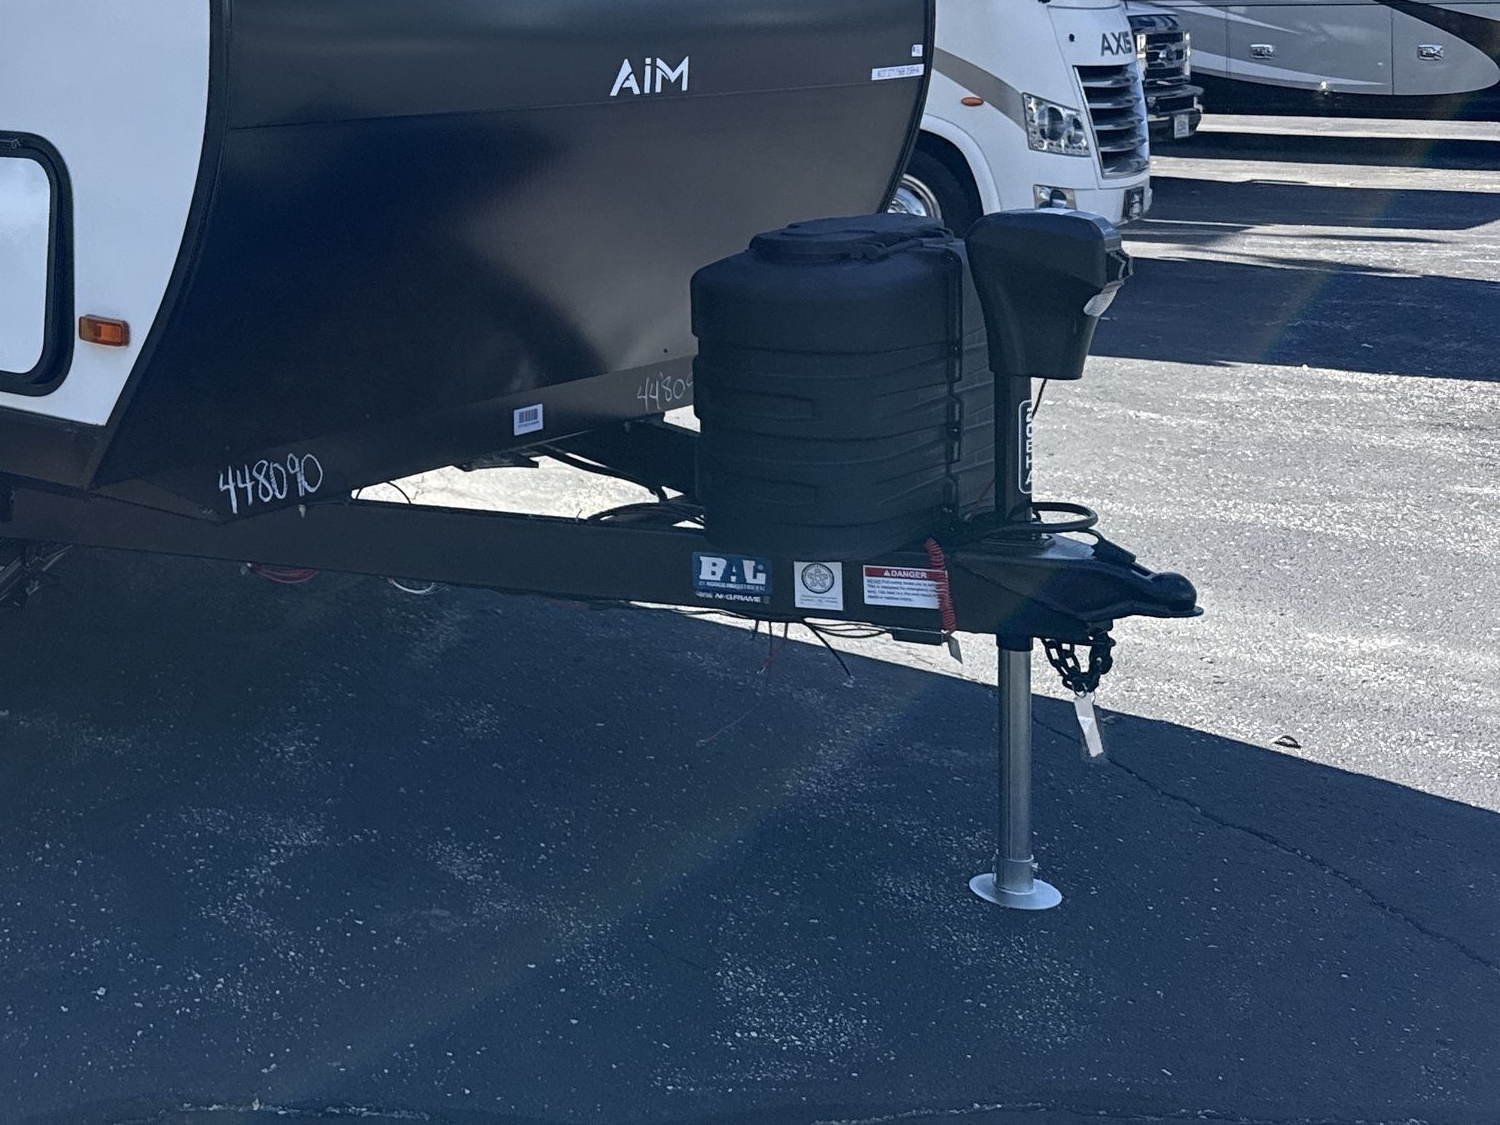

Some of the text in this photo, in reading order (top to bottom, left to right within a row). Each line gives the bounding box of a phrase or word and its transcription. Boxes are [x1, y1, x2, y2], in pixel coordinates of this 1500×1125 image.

[1101, 31, 1132, 56] AXIS
[219, 453, 323, 514] 448090
[699, 556, 766, 585] BAL
[890, 569, 928, 579] DANGER
